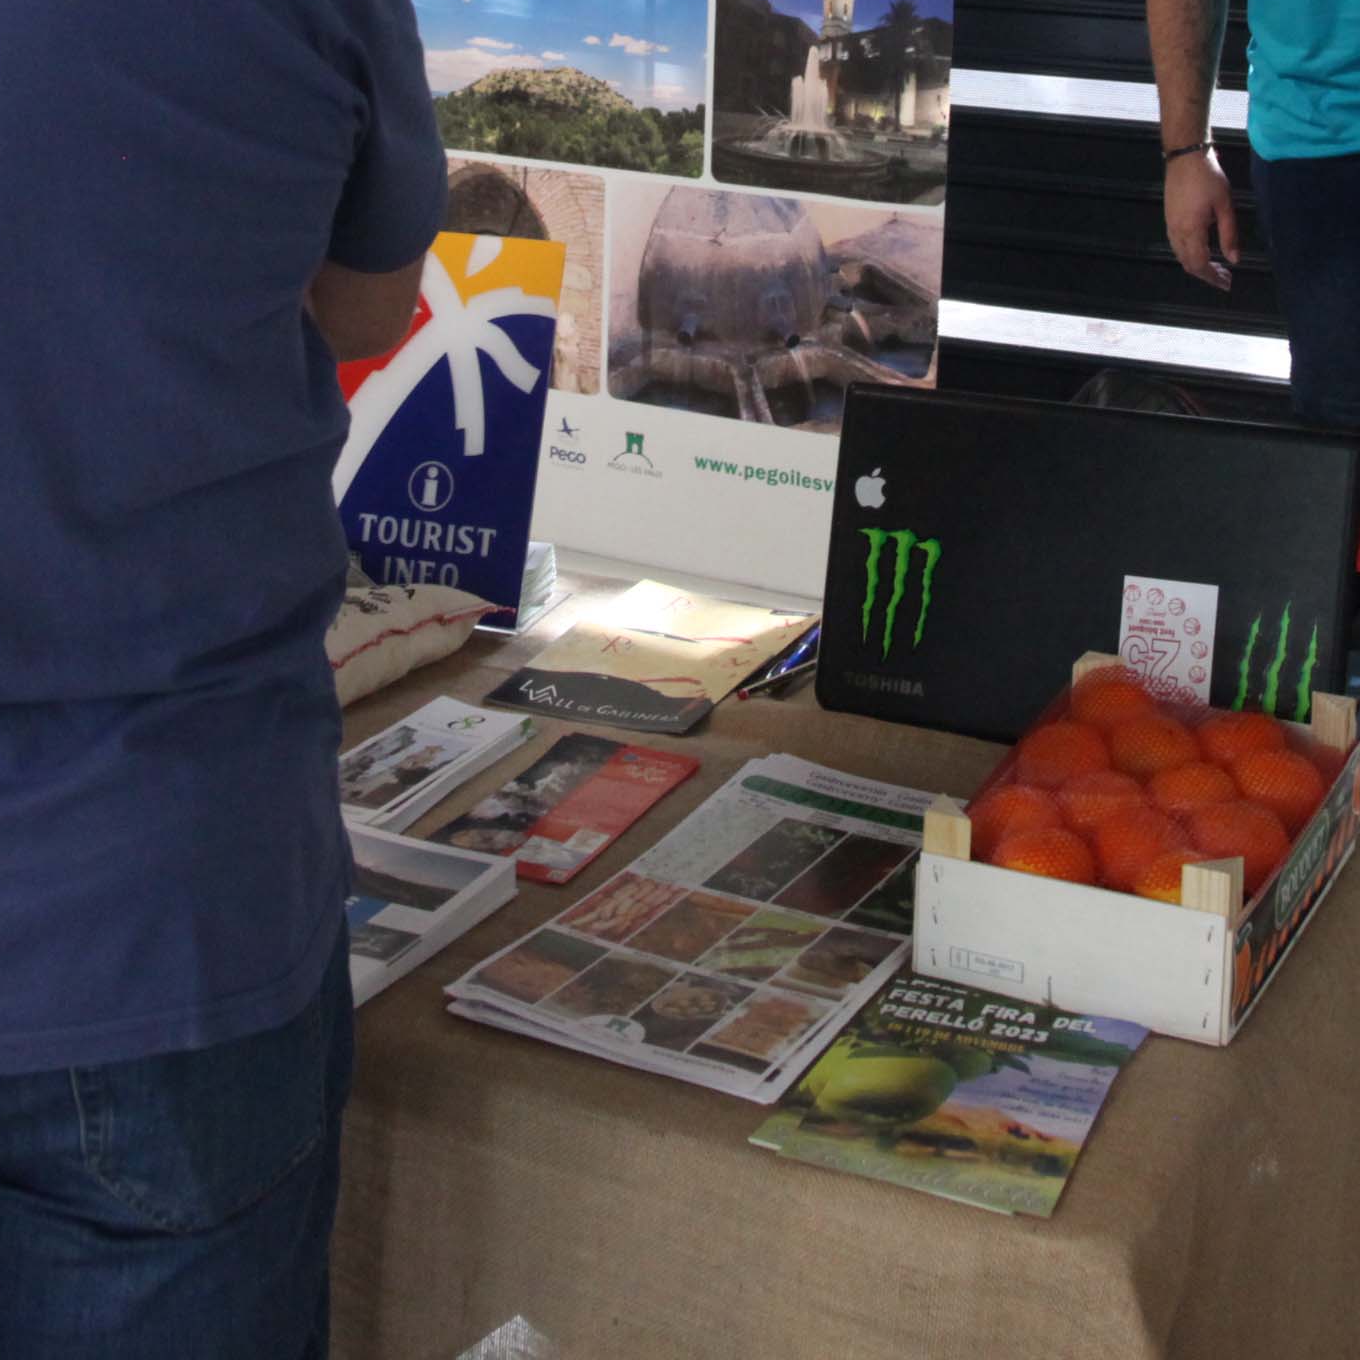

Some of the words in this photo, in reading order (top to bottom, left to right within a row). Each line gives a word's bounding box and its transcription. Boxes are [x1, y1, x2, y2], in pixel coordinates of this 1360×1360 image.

[358, 512, 498, 559] TOURIST
[383, 554, 460, 588] INFO
[842, 672, 925, 698] TOSHIBA
[879, 1003, 985, 1032] PERELLÓ
[989, 1021, 1051, 1043] 2023
[887, 988, 966, 1013] FESTA
[979, 1003, 1037, 1025] FIRA
[1051, 1016, 1098, 1034] DEL
